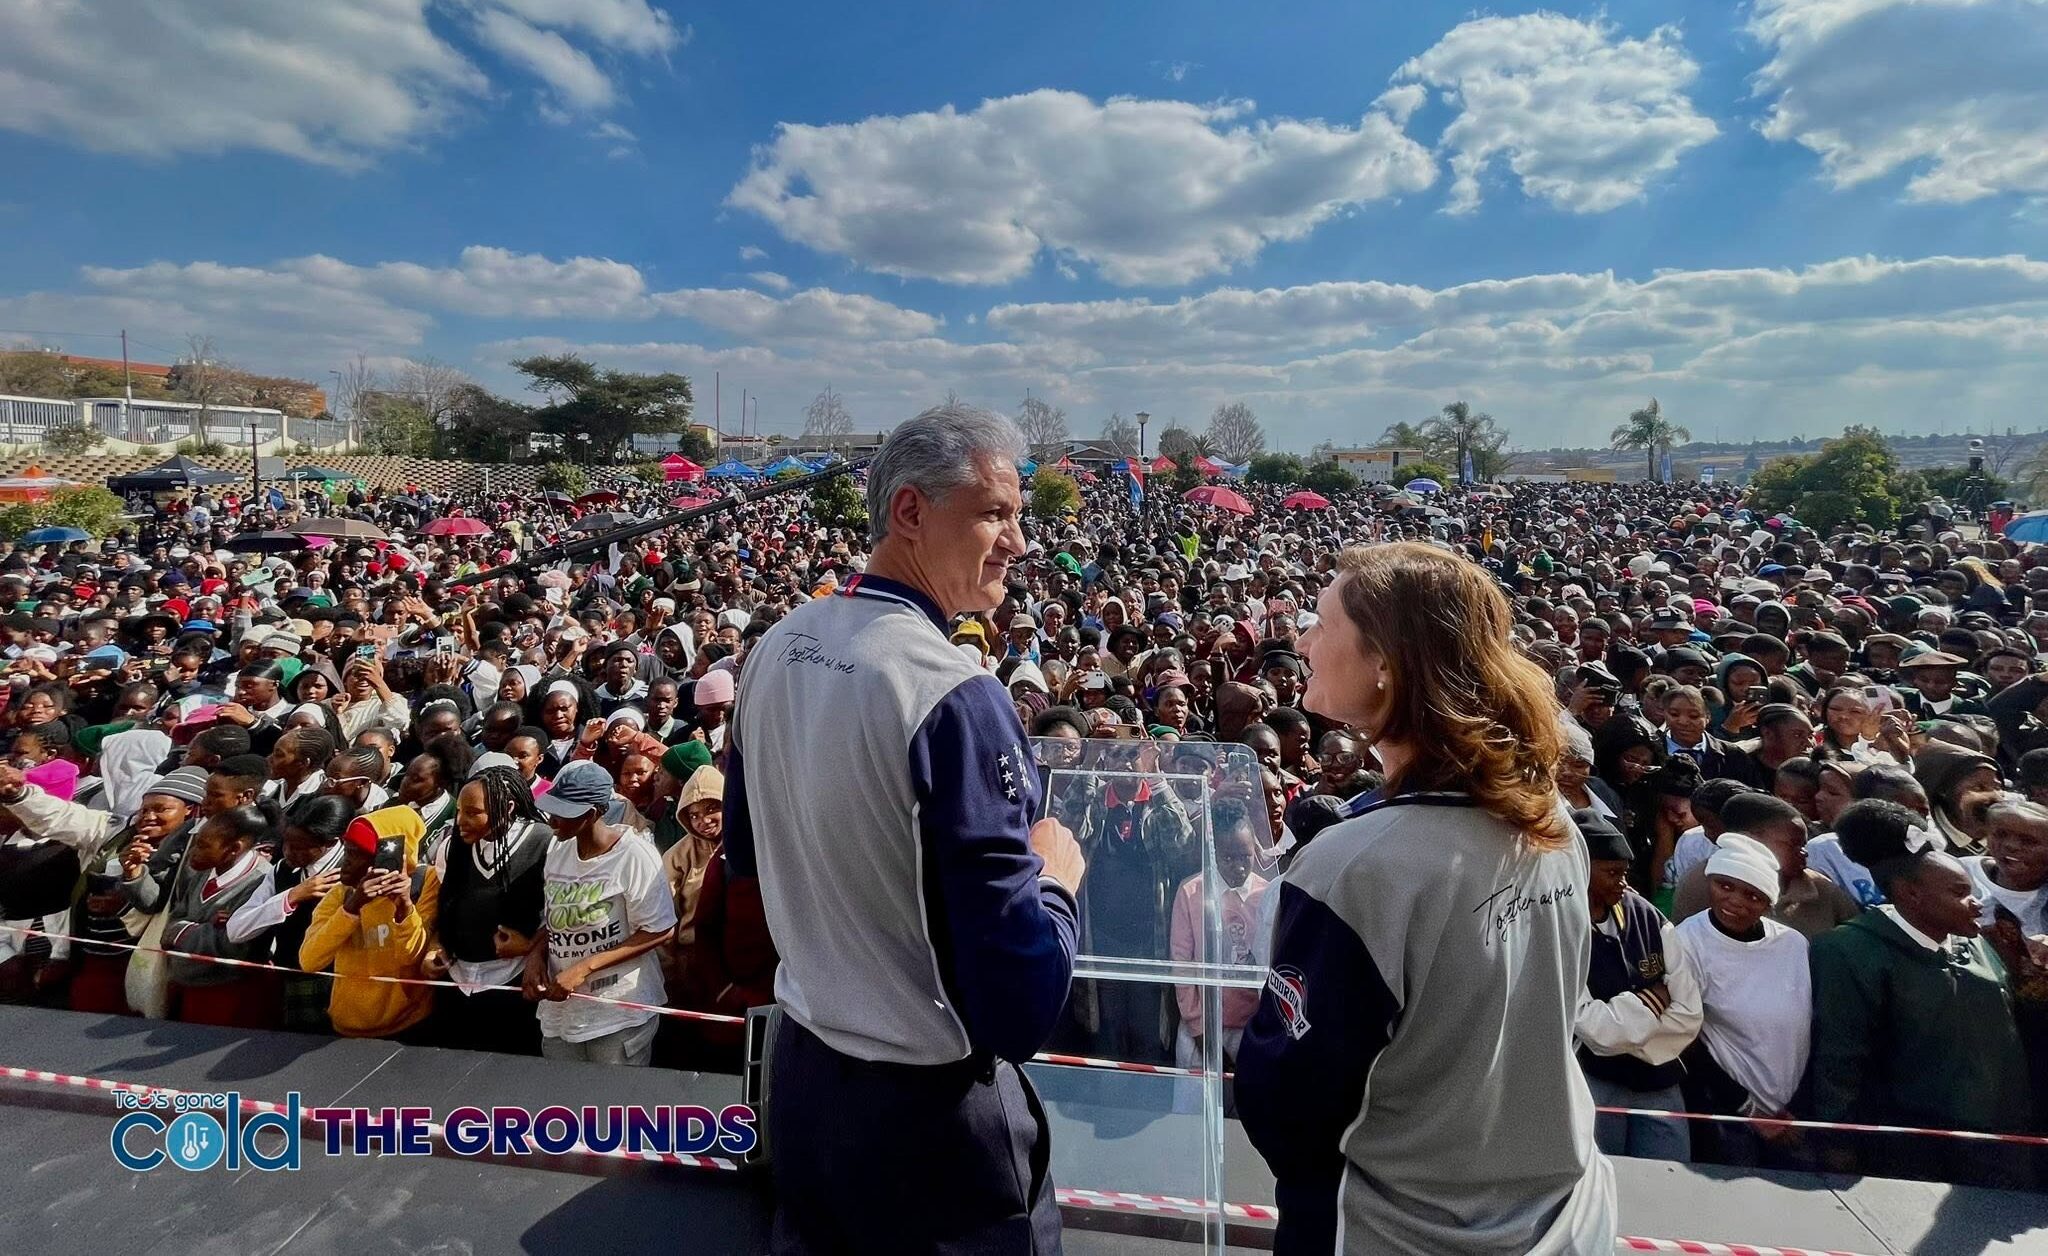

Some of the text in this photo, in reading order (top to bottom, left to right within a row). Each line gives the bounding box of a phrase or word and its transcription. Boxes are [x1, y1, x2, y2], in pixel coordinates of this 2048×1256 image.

[1472, 884, 1536, 947] Together
[1554, 883, 1575, 901] one
[571, 949, 586, 958] MY
